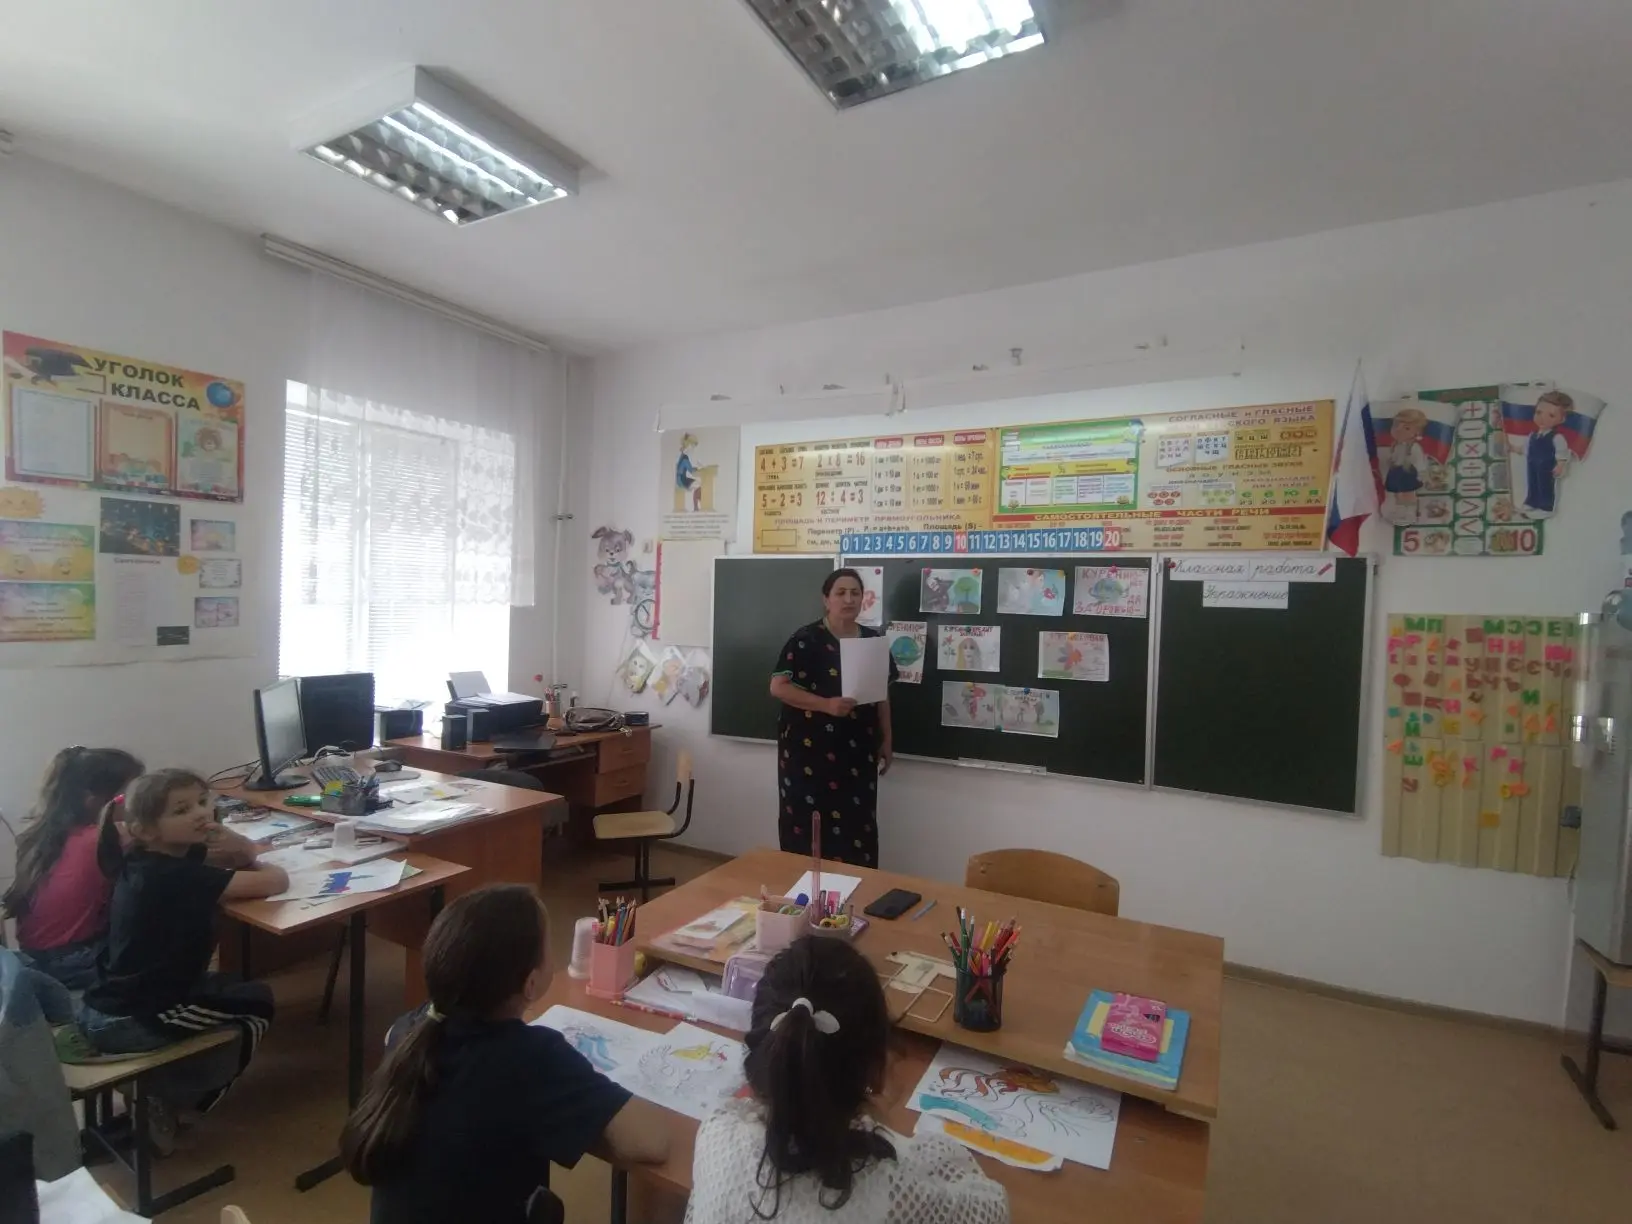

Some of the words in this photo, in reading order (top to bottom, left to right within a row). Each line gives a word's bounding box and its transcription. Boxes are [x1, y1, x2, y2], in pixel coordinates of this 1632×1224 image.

[93, 356, 184, 388] УГОЛОК
[111, 382, 200, 411] КЛАССА
[1168, 412, 1239, 423] СОГЛАСНЫЕ
[1254, 405, 1313, 416] ГЛАСНЫЕ
[1273, 414, 1316, 424] ЯЗЫКА
[782, 456, 787, 472] 3
[799, 456, 804, 470] 7
[817, 454, 823, 468] 2
[762, 494, 767, 508] 5
[780, 493, 786, 507] 2
[797, 492, 802, 506] 3
[816, 490, 826, 506] 12
[840, 490, 846, 504] 4
[858, 489, 864, 504] 3
[1034, 511, 1162, 520] САМОСТОЯТЕЛЬНЫЕ
[1176, 509, 1223, 517] ЧАСТИ
[1231, 508, 1270, 516] РЕЧИ
[842, 536, 849, 552] 0
[854, 536, 859, 551] 1
[863, 536, 871, 551] 2
[875, 535, 881, 550] 3
[886, 535, 892, 550] 4
[897, 534, 904, 550] 5
[909, 534, 916, 549] 6
[921, 534, 927, 549] 7
[933, 534, 939, 549] 8
[944, 534, 952, 549] 9
[956, 534, 967, 550] 10
[970, 534, 980, 549] 11
[983, 533, 996, 549] 12
[998, 533, 1010, 549] 13
[1012, 533, 1026, 549] 14
[1028, 533, 1040, 548] 15
[1043, 532, 1056, 548] 16
[1059, 532, 1071, 547] 17
[1074, 532, 1087, 547] 18
[1089, 531, 1103, 546] 19
[1105, 530, 1119, 547] 20
[1403, 530, 1420, 552] 5
[1510, 529, 1536, 552] 10
[1174, 558, 1245, 574] Классная
[1251, 558, 1316, 580] работа
